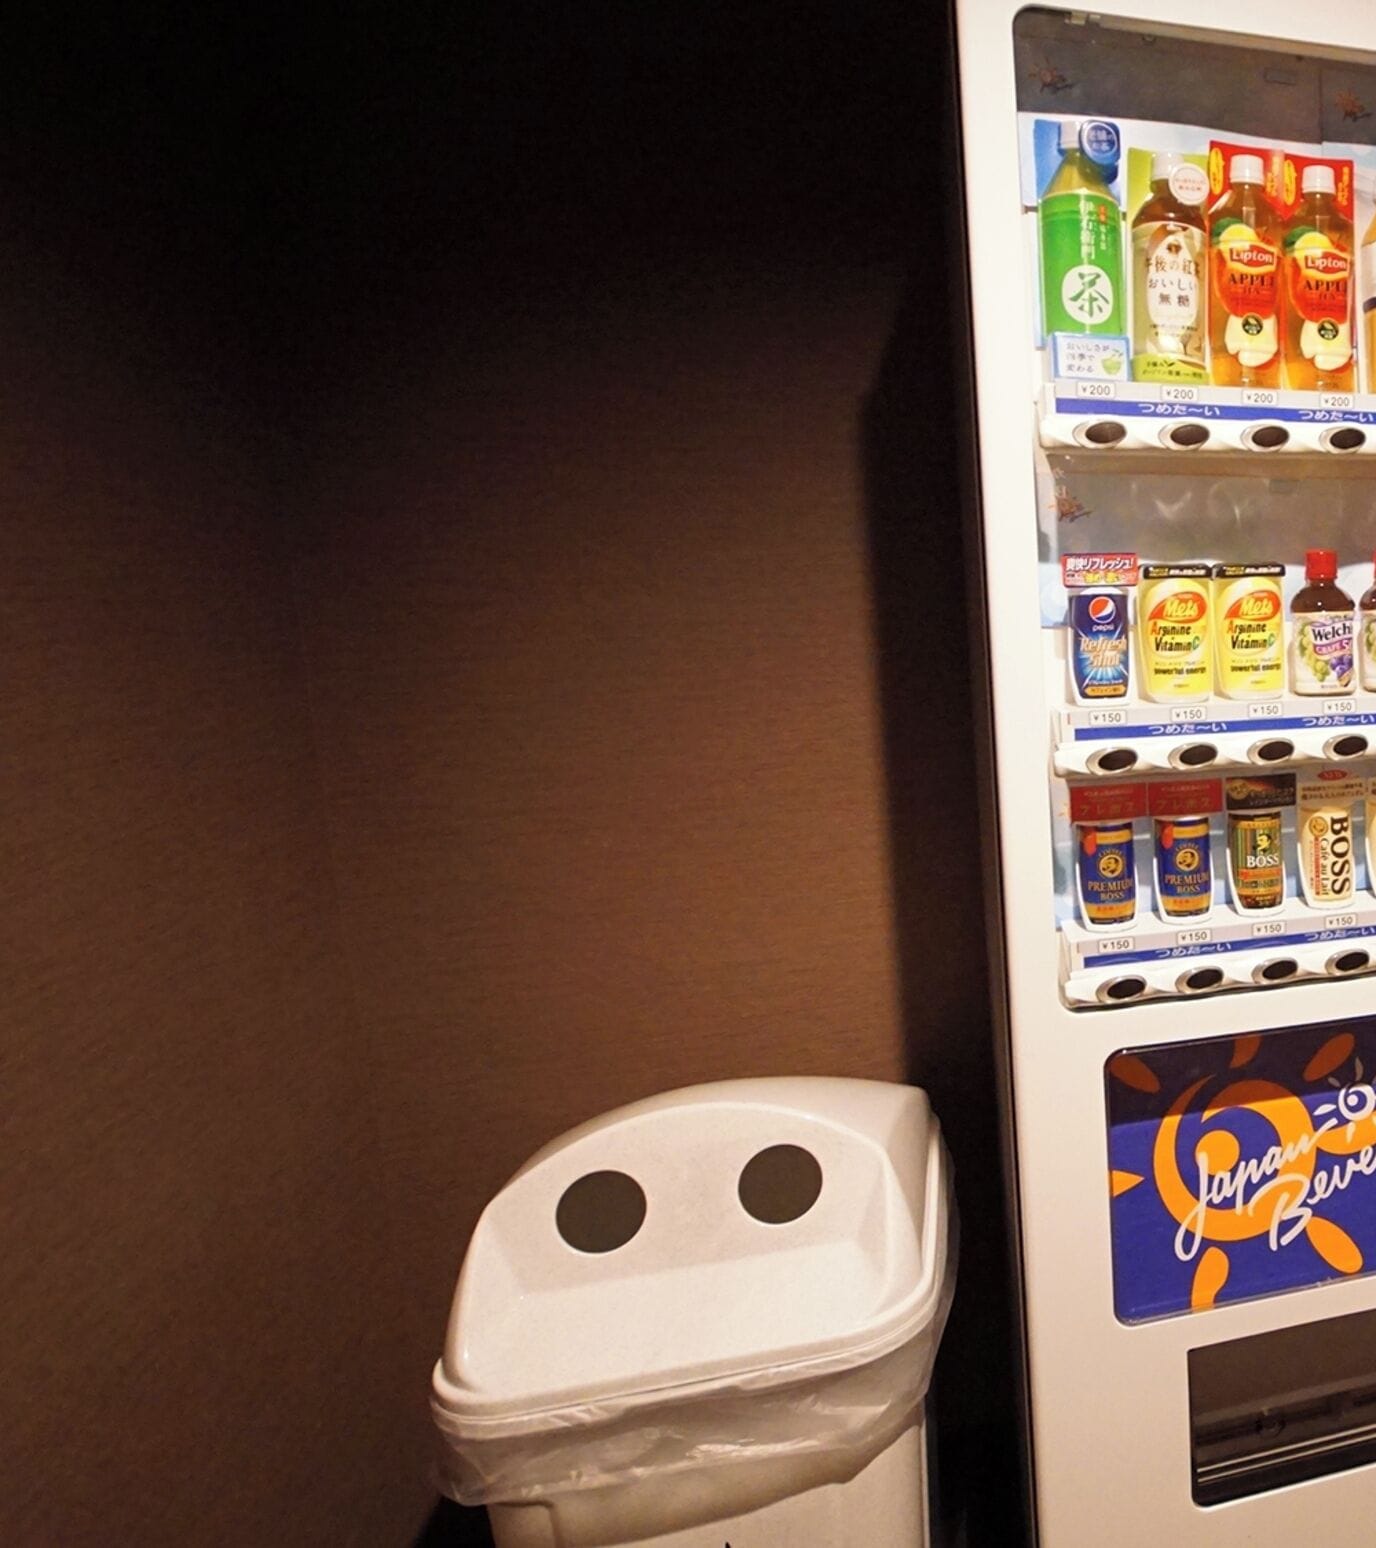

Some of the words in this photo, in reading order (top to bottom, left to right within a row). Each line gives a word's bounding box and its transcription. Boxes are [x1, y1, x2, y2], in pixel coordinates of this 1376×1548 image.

[1232, 250, 1273, 262] Lipton
[1308, 255, 1346, 269] Lipton
[1069, 272, 1109, 318] 茶
[1159, 293, 1190, 307] 無糖
[1163, 597, 1199, 617] Mets
[1240, 596, 1273, 615] Mets
[1092, 624, 1115, 632] pepsi
[1151, 622, 1191, 636] Arginine
[1227, 620, 1267, 633] Arginine
[1312, 622, 1353, 640] Welch
[1246, 855, 1279, 868] BOSS
[1331, 816, 1350, 895] BOSS
[1174, 1118, 1338, 1262] Japan
